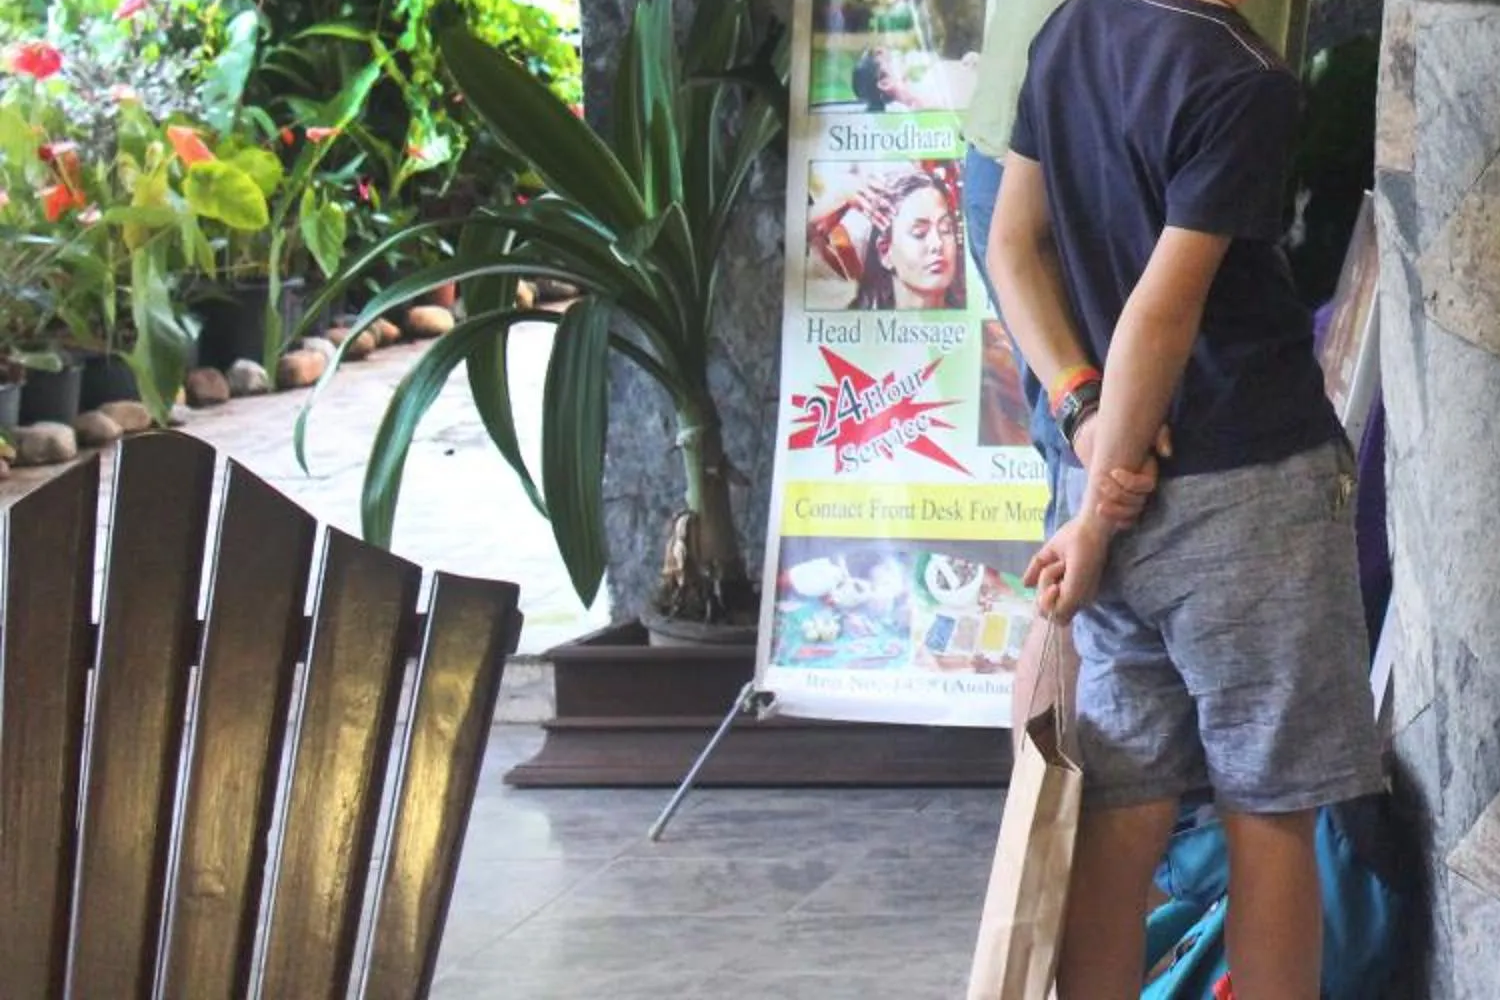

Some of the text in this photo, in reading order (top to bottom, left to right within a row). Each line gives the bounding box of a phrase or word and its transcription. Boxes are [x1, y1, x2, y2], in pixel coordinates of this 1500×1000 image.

[828, 124, 954, 152] Shirodhara
[805, 317, 966, 349] Head Massage
[805, 365, 925, 443] 24 Hour
[841, 412, 930, 473] Service
[795, 497, 1045, 522] Contact Front Desk For More
